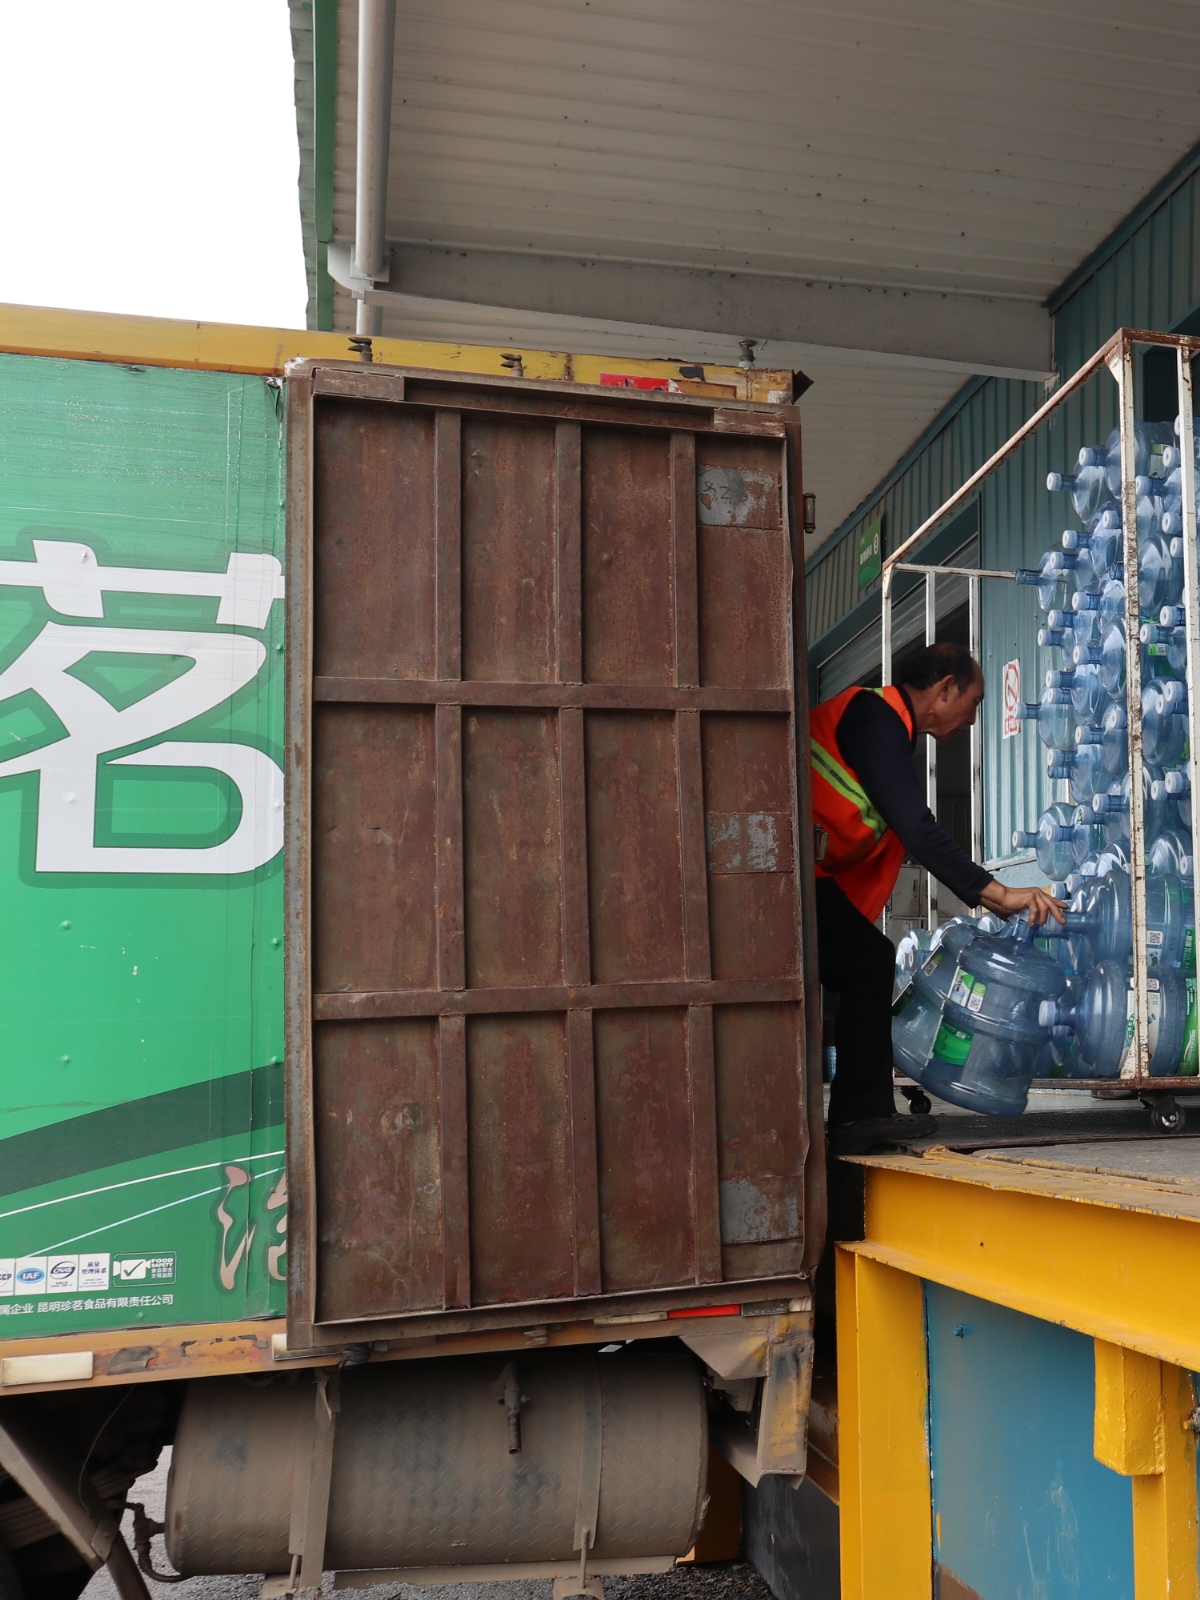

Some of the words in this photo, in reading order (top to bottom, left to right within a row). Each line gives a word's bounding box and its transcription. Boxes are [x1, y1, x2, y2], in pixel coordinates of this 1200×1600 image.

[0, 1273, 12, 1281] CP
[22, 1272, 40, 1280] IAF
[37, 1294, 174, 1313] 昆明珍茗食品有限责任公司
